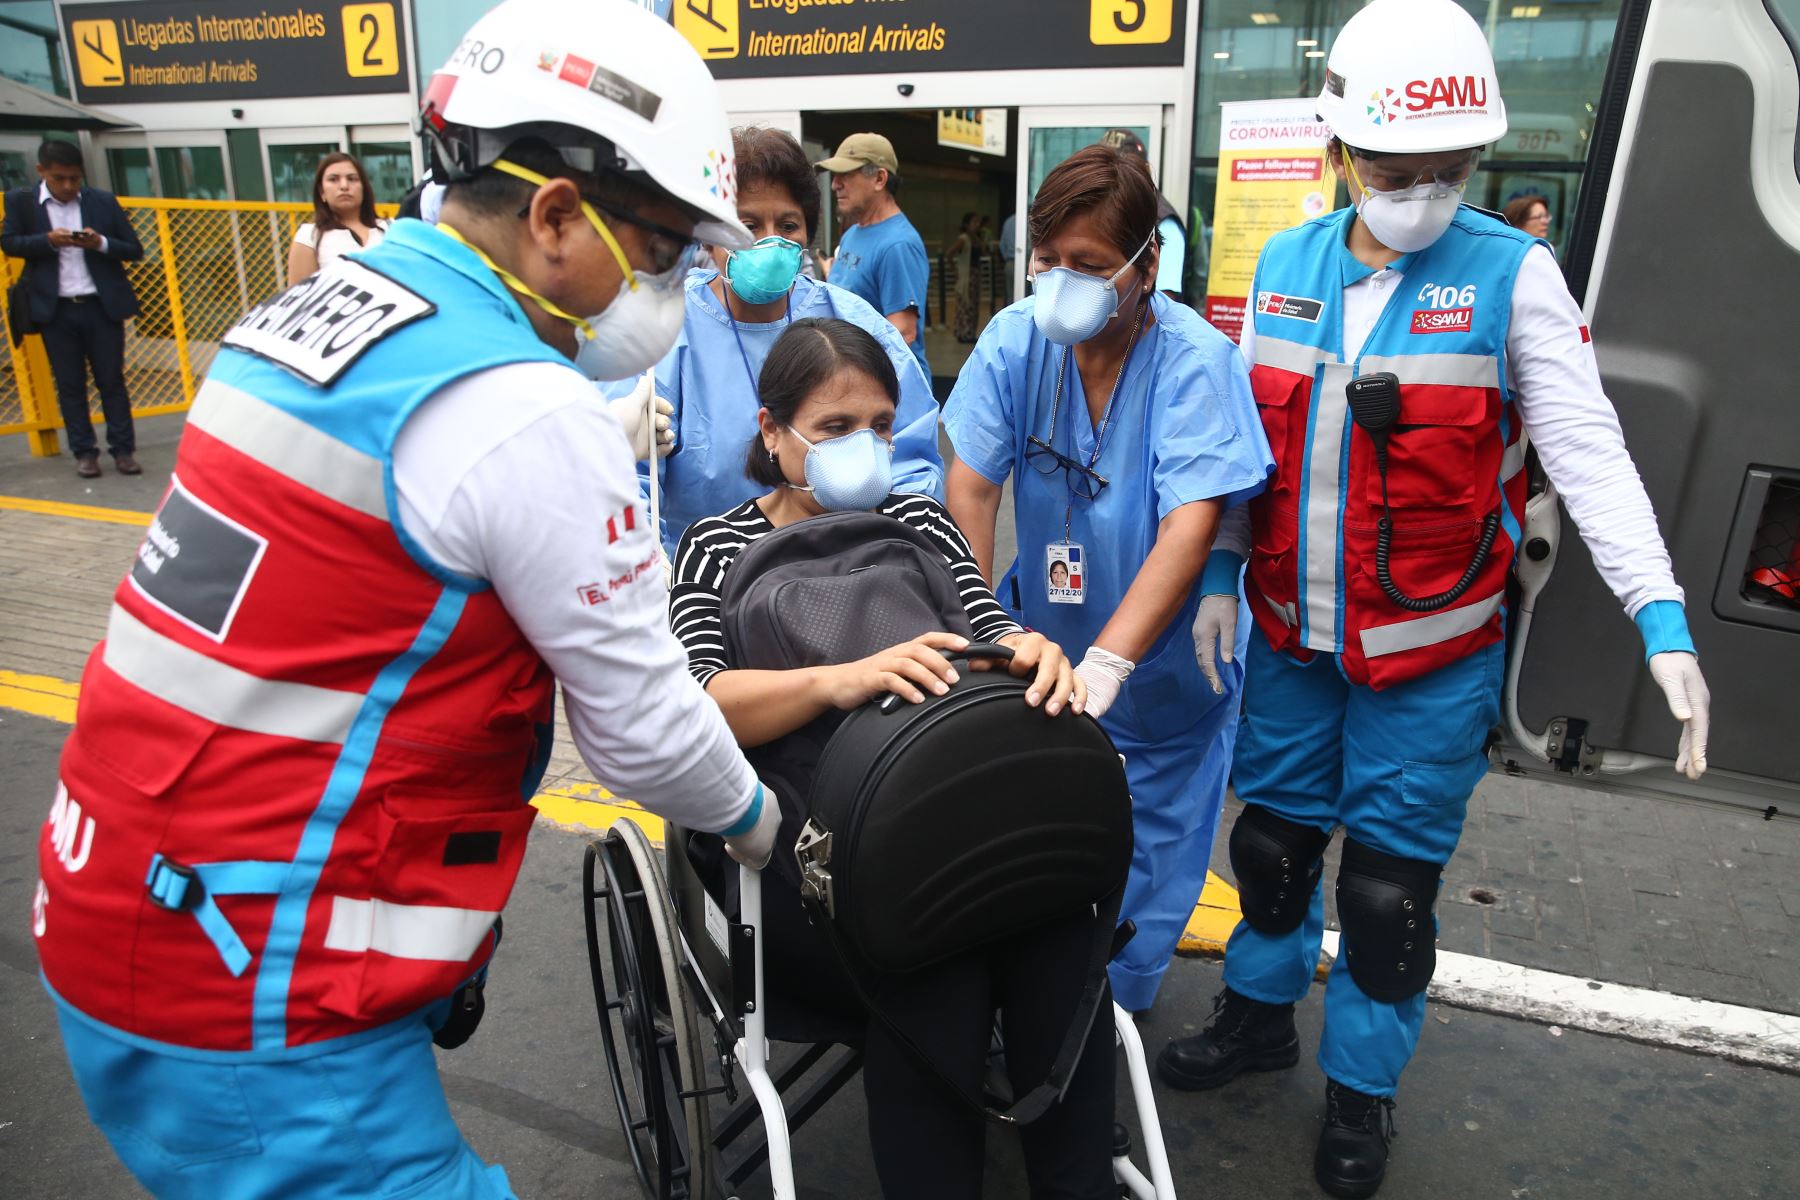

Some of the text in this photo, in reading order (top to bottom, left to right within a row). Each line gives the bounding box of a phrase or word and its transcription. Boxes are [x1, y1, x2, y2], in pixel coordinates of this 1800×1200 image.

[122, 9, 327, 51] Llegadas Internacionales
[359, 13, 383, 67] 2
[748, 22, 946, 57] International Arrivals
[129, 60, 258, 86] International Arrivals
[1405, 76, 1487, 112] SAMU
[1229, 124, 1332, 140] CORONAVIRUS
[1426, 284, 1477, 309] 106
[1431, 311, 1470, 326] SAMU
